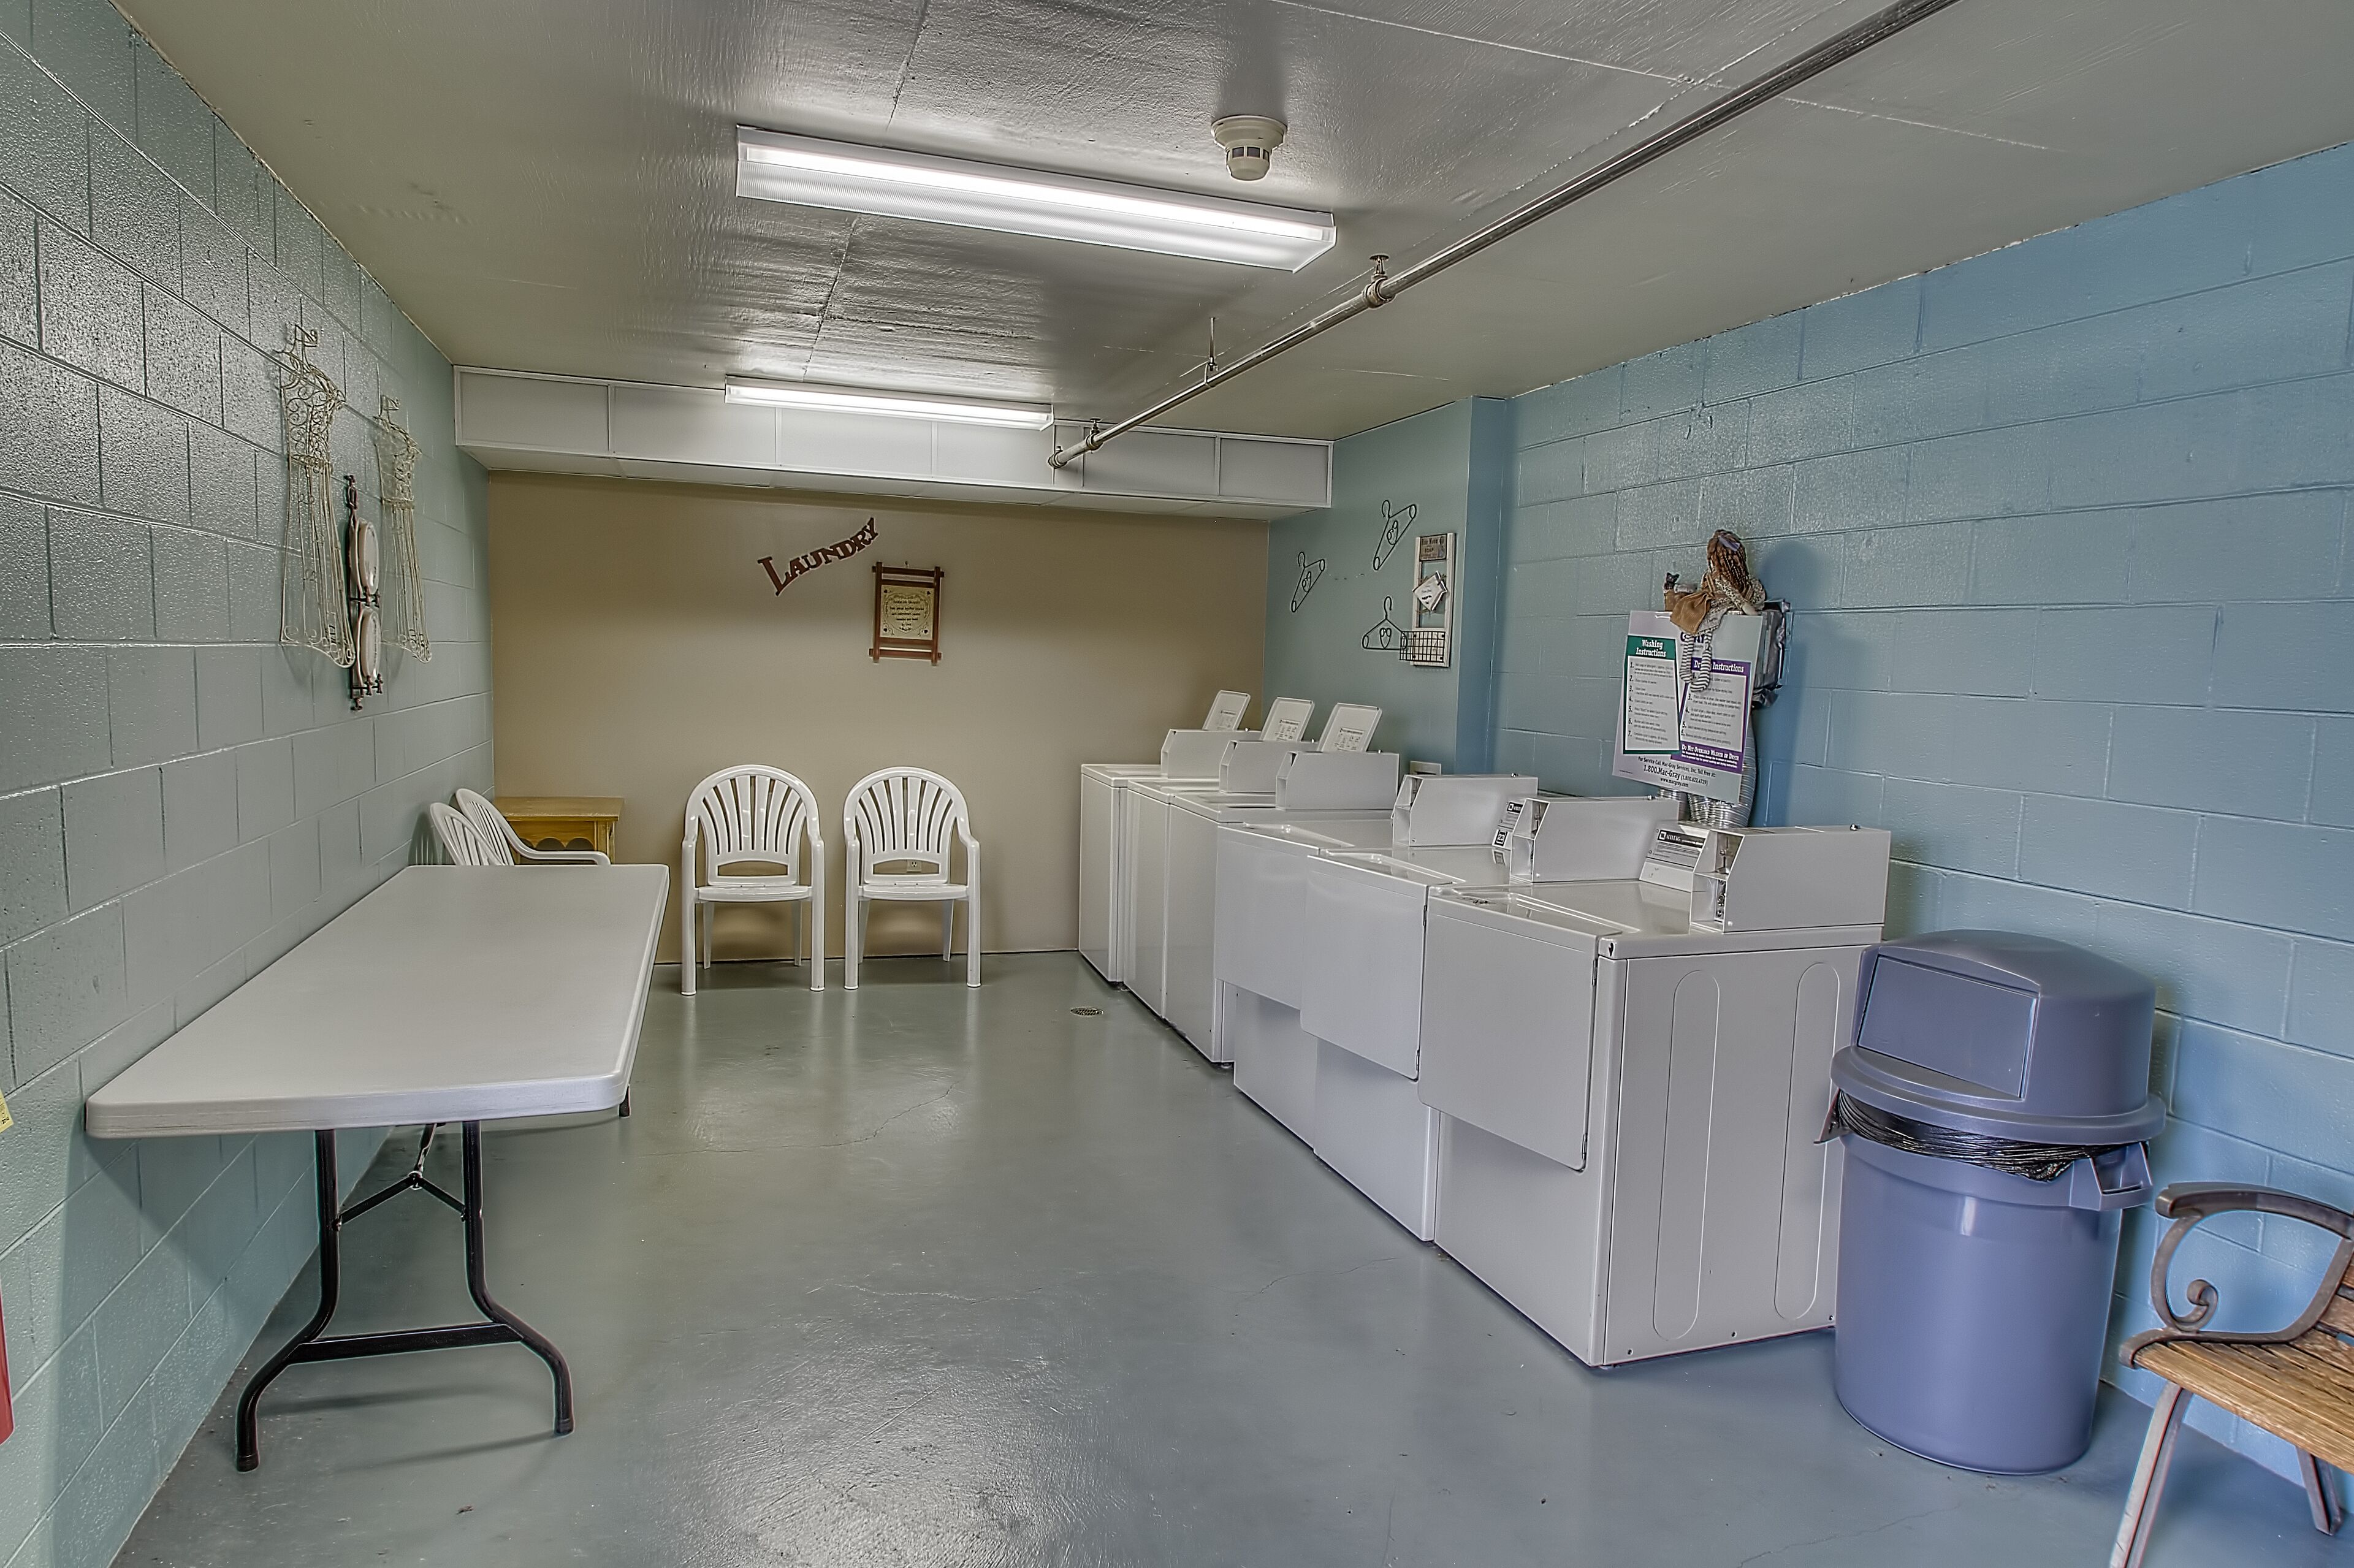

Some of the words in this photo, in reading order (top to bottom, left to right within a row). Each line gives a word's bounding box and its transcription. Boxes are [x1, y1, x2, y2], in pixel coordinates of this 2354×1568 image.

[1642, 639, 1663, 650] Washing
[1636, 647, 1666, 657] Instructions
[1713, 662, 1744, 672] Instructions
[1644, 764, 1680, 780] 1.800.Mac-Gray
